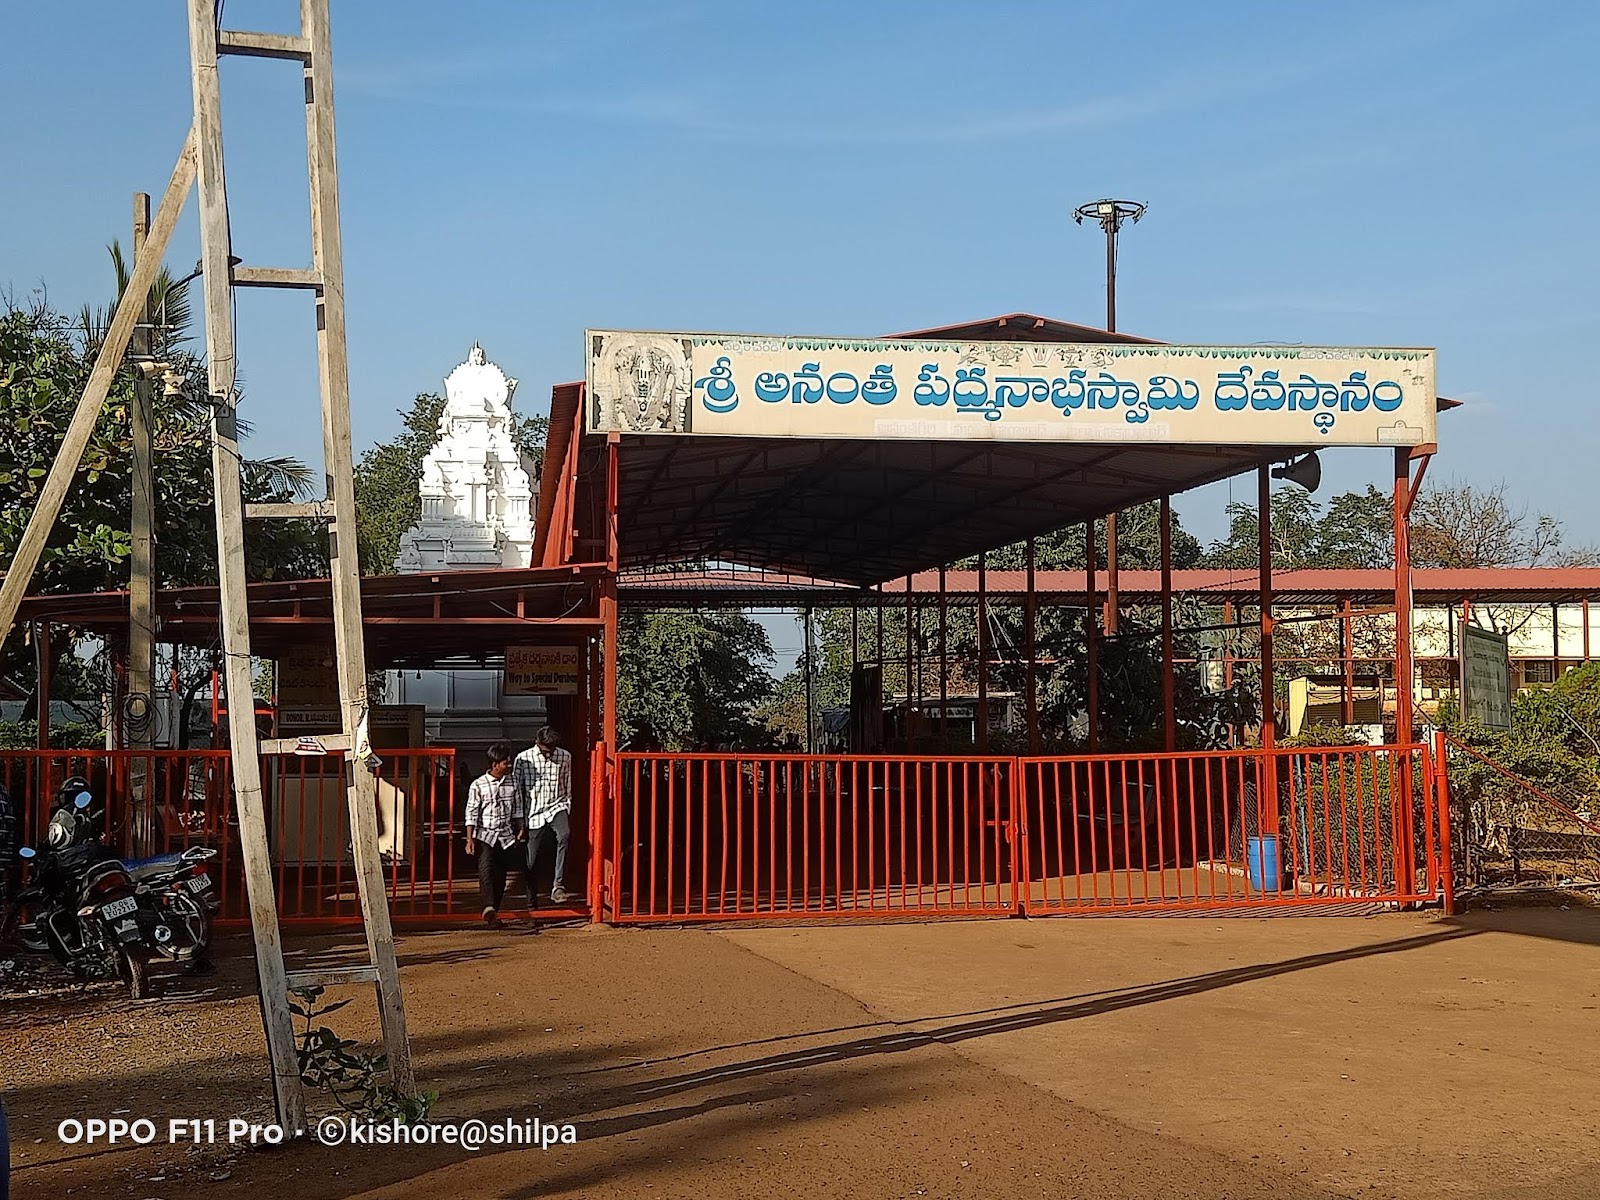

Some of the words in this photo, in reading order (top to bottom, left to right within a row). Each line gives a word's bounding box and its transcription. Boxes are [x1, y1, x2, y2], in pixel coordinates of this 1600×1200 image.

[695, 356, 739, 413] శ్రీ
[754, 363, 898, 405] అనంత
[913, 364, 1200, 424] పద్మనాభస్వామి
[1214, 365, 1403, 434] దేవస్థానం
[509, 672, 523, 685] Way
[524, 672, 531, 683] to
[532, 672, 553, 685] Special
